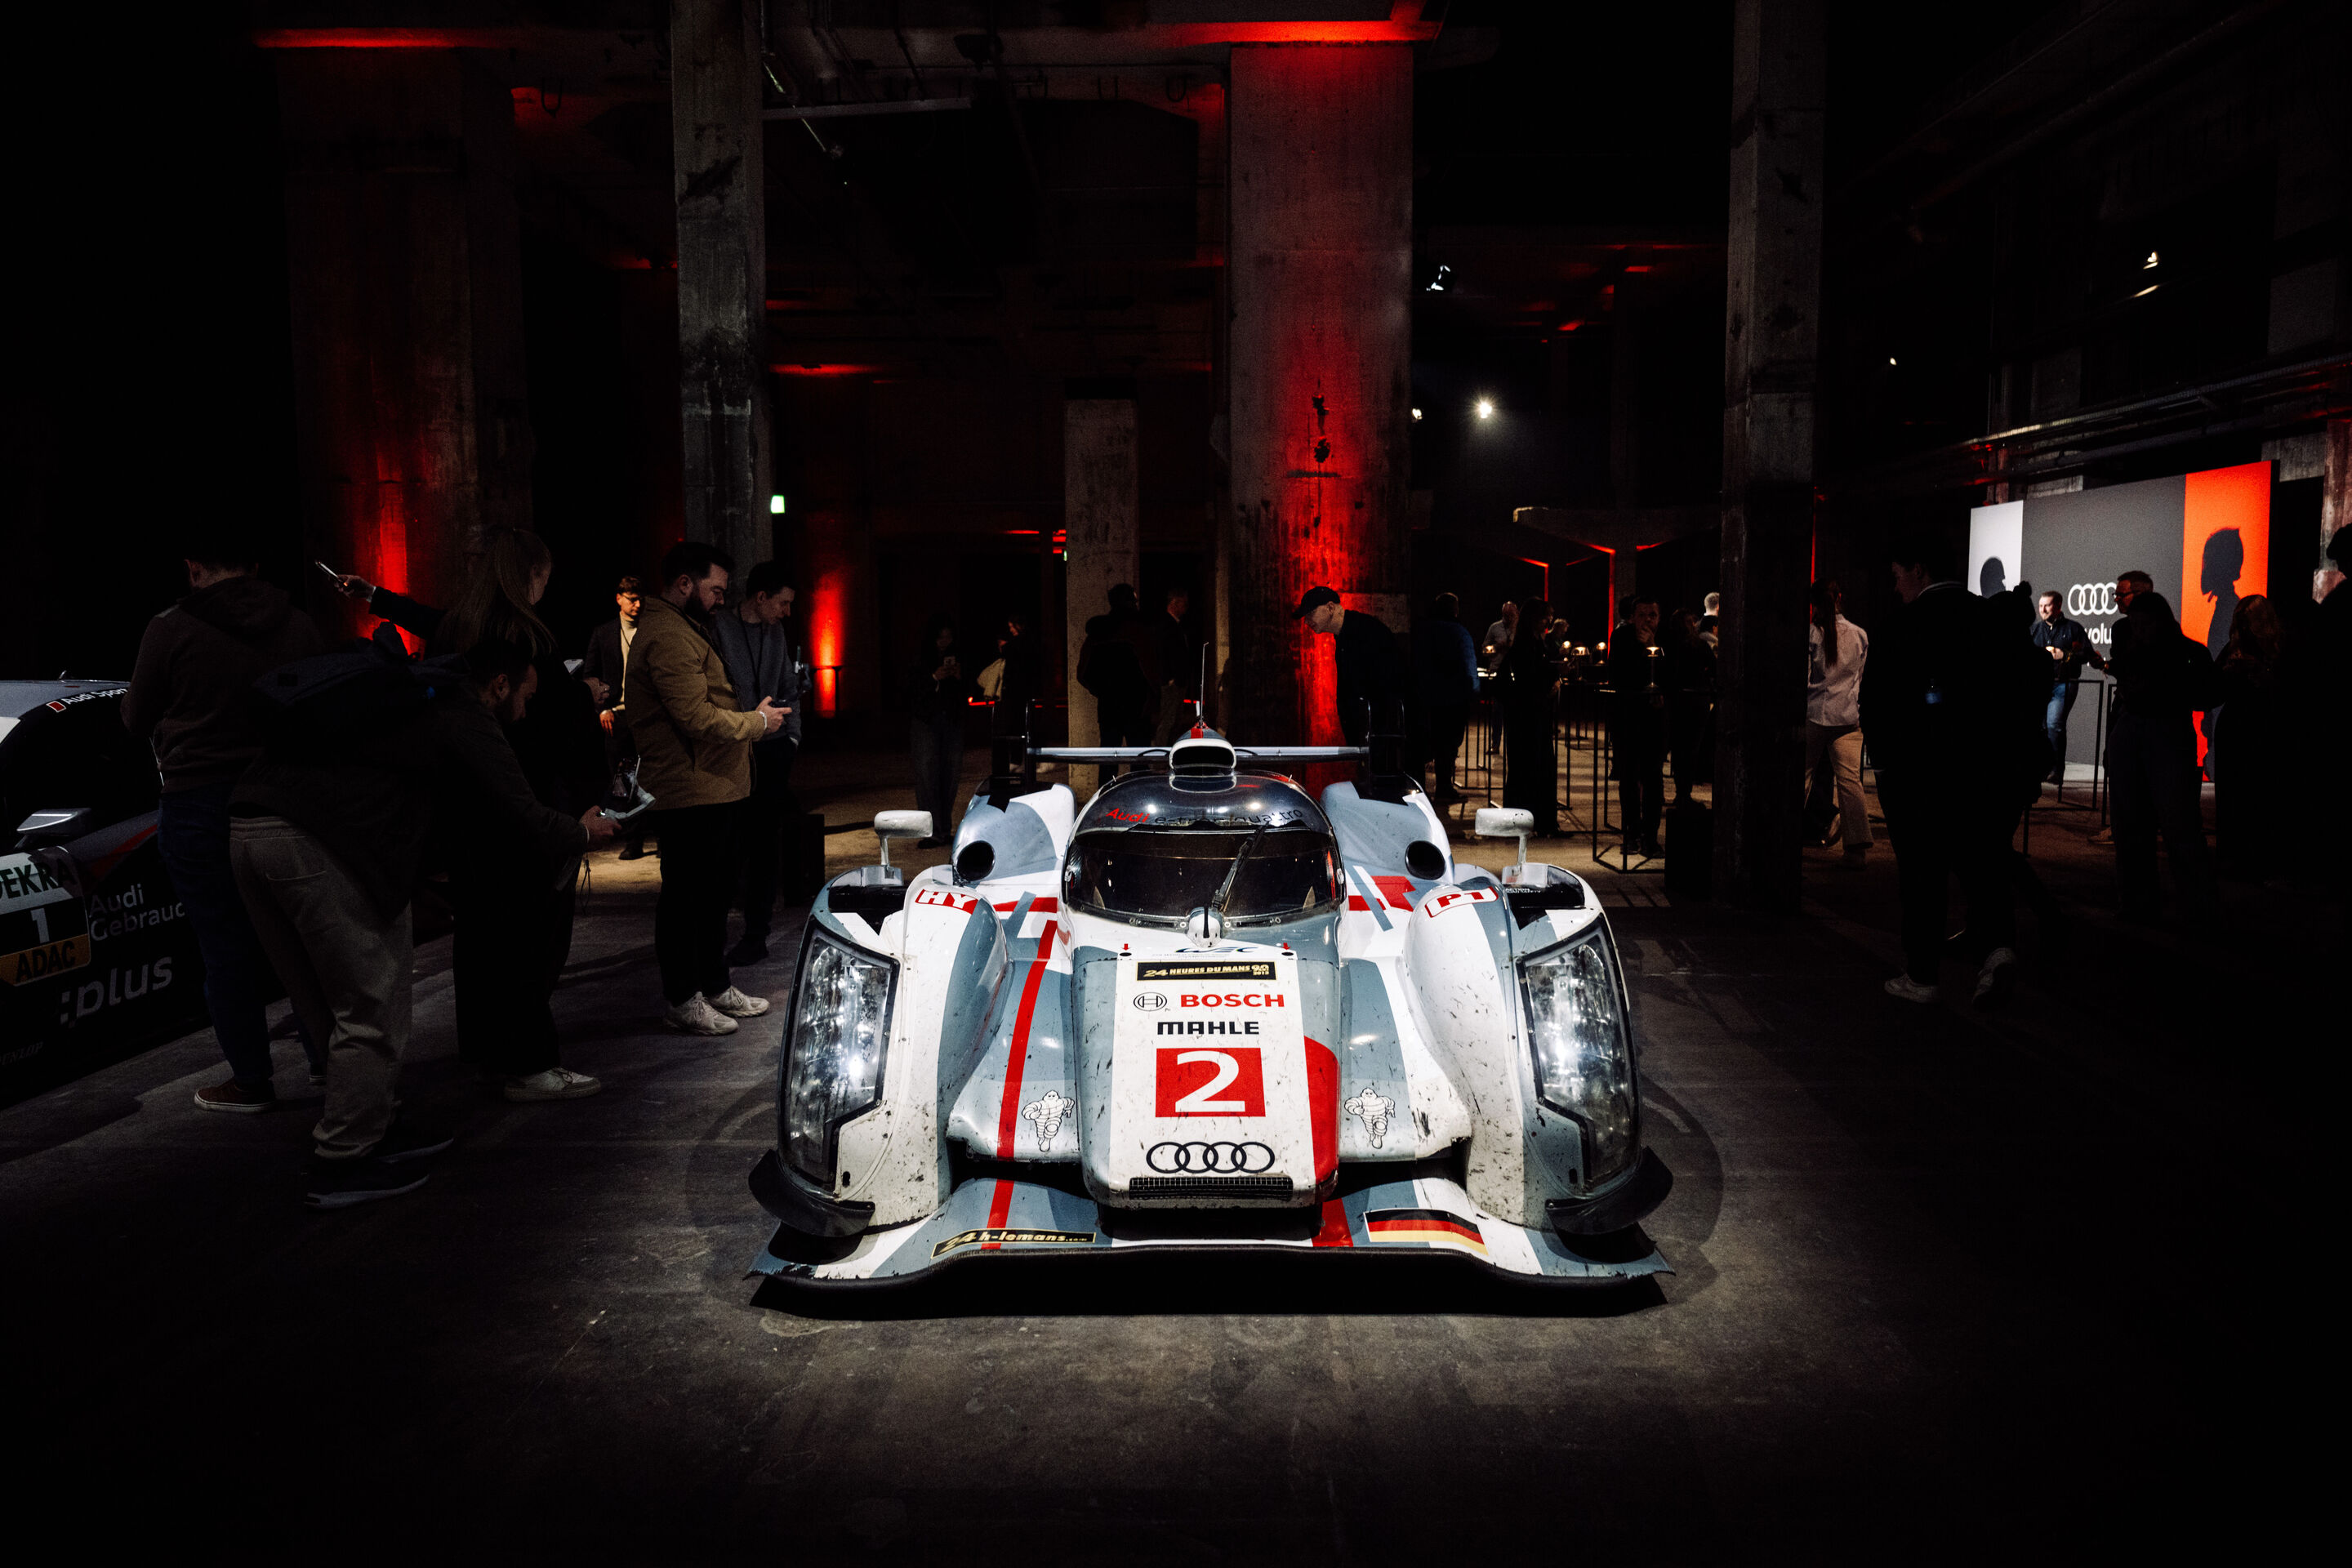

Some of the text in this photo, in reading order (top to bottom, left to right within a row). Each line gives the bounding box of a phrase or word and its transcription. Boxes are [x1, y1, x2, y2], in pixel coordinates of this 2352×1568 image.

[2084, 622, 2113, 644] volu
[61, 693, 96, 705] Audi
[1106, 808, 1150, 823] Audi
[0, 858, 78, 899] EKRA
[89, 883, 145, 918] Audi
[918, 891, 977, 909] HY
[30, 907, 51, 944] 1
[90, 902, 186, 942] Gebrauc
[16, 941, 75, 982] ADAC
[1143, 969, 1169, 978] 24
[1169, 967, 1205, 975] HEURES
[1180, 994, 1285, 1008] BOSCH
[1157, 1022, 1259, 1035] MAHLE
[1175, 1050, 1245, 1112] 2
[939, 1232, 978, 1254] 24
